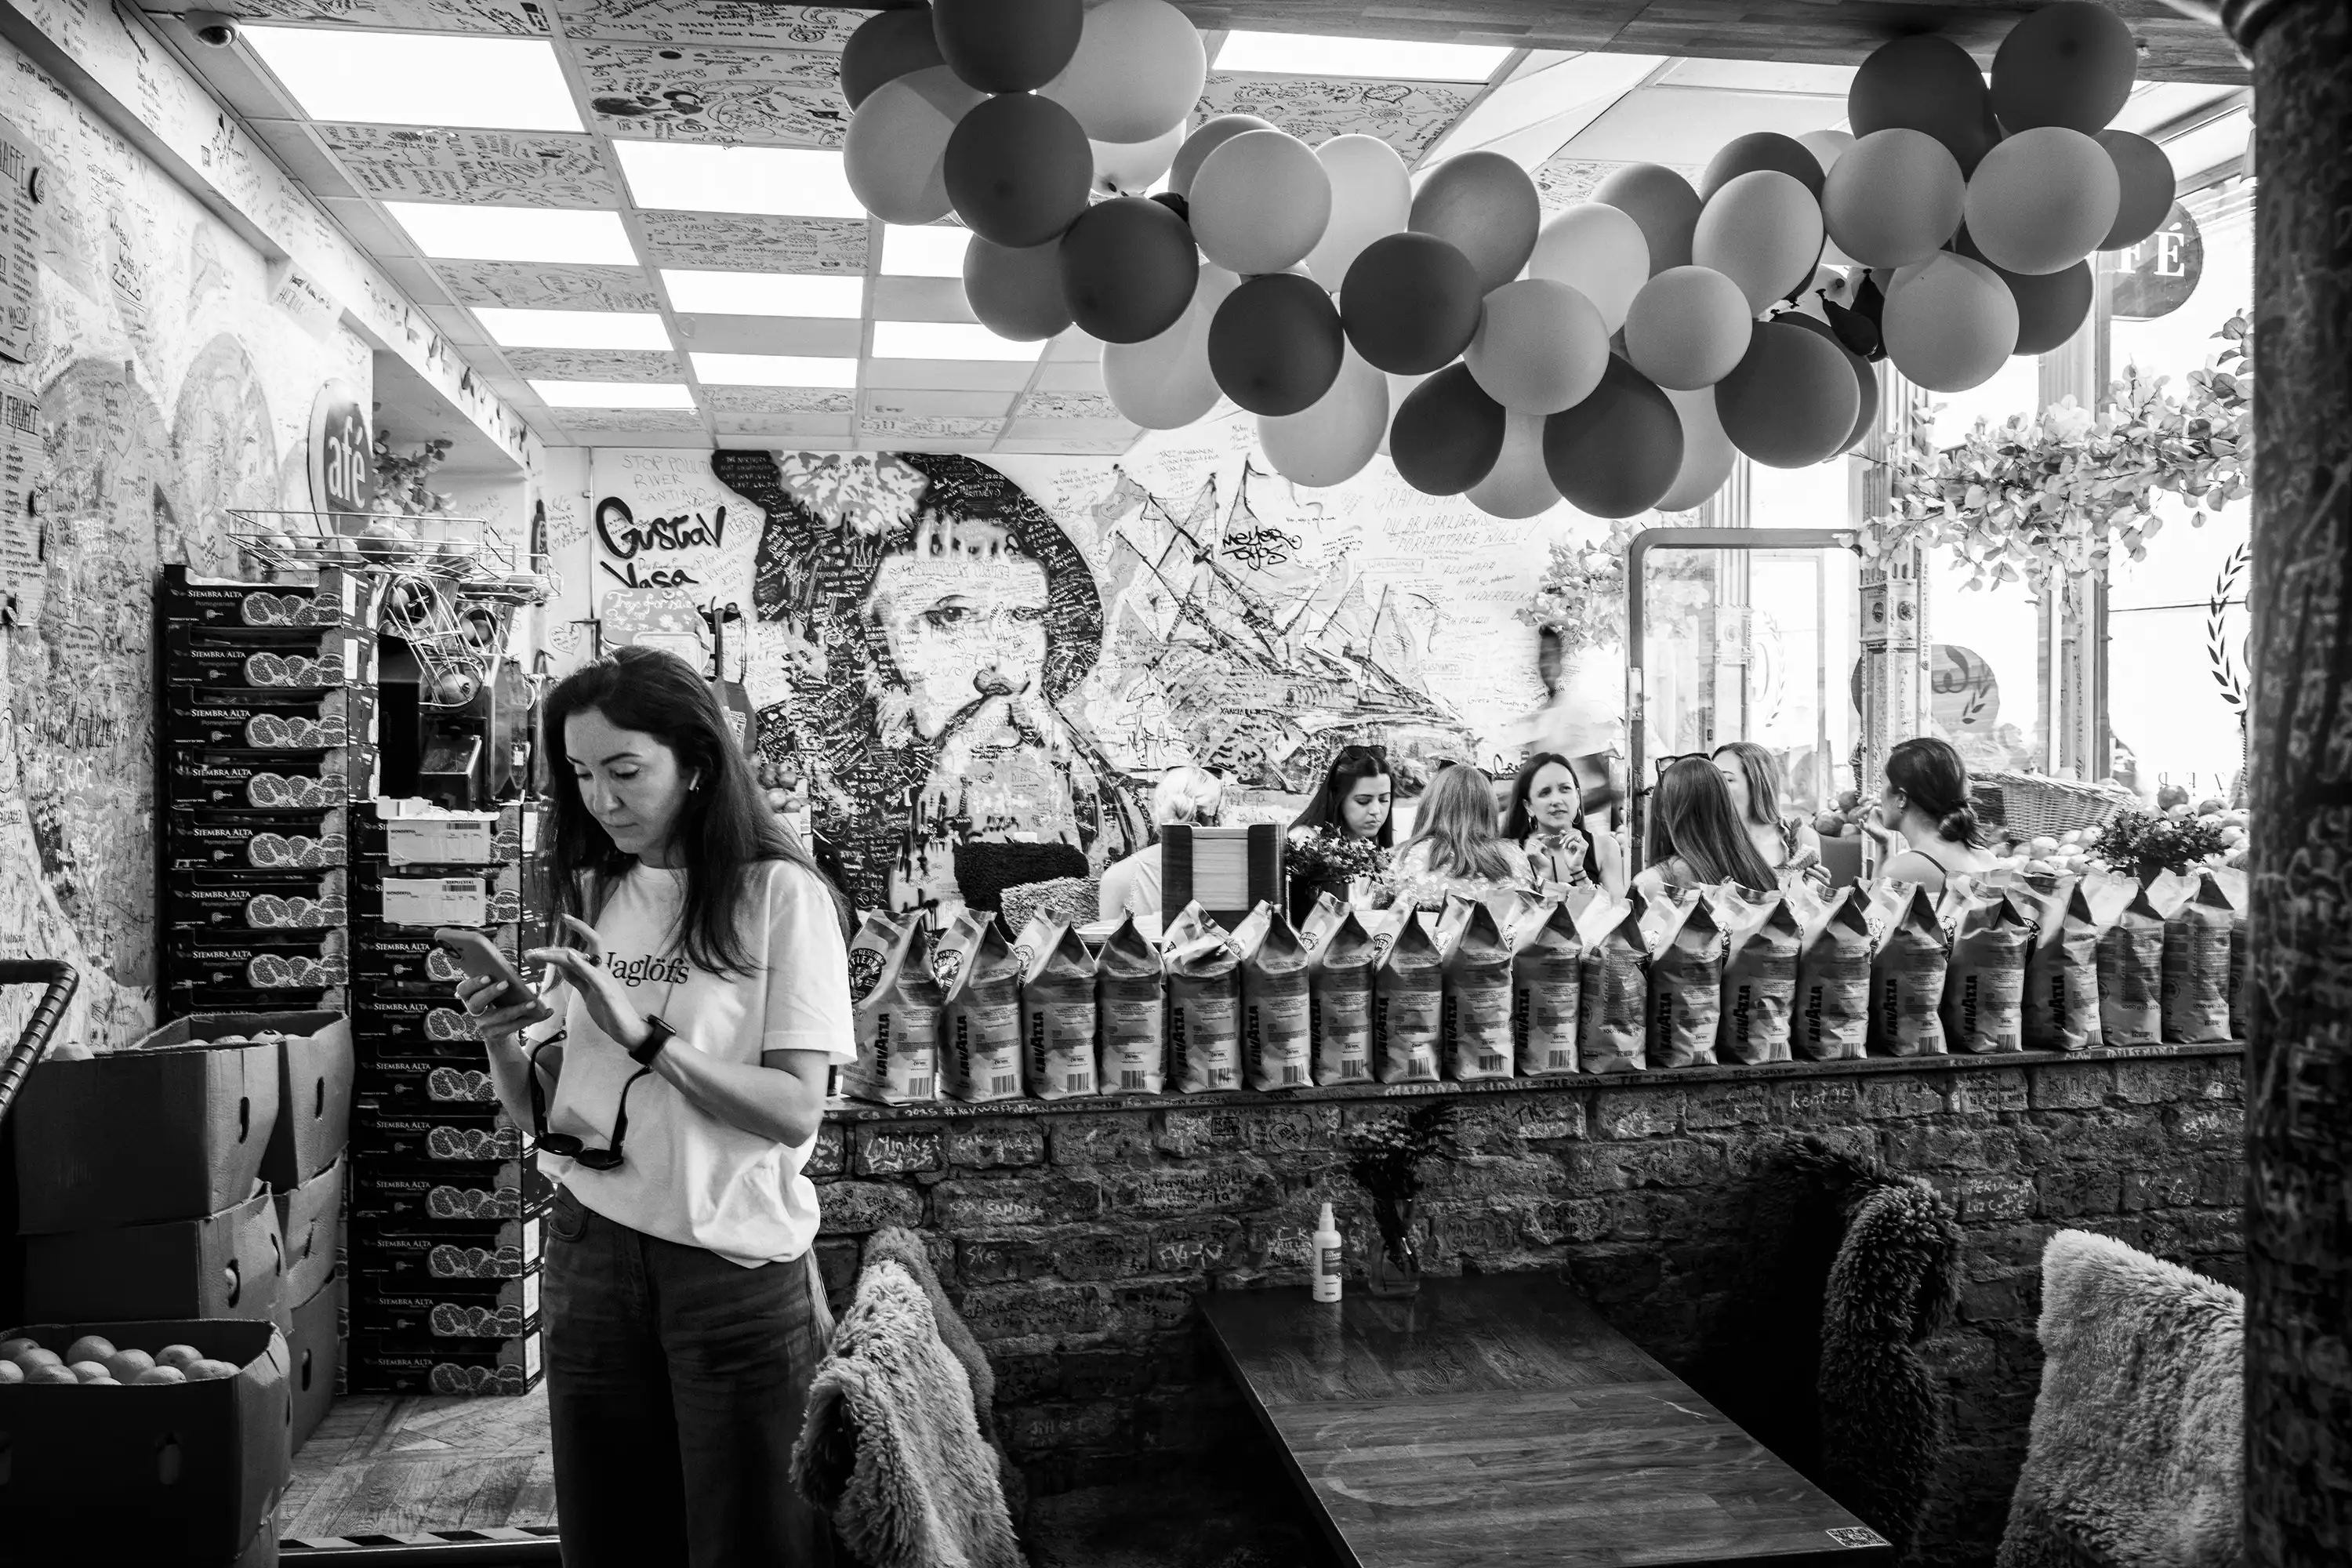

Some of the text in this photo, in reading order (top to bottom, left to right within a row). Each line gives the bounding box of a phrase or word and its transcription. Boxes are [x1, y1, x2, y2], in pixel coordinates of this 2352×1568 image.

[188, 590, 244, 599] SIEMBRA ALTA
[193, 950, 252, 959] SIEMBRA ALTA
